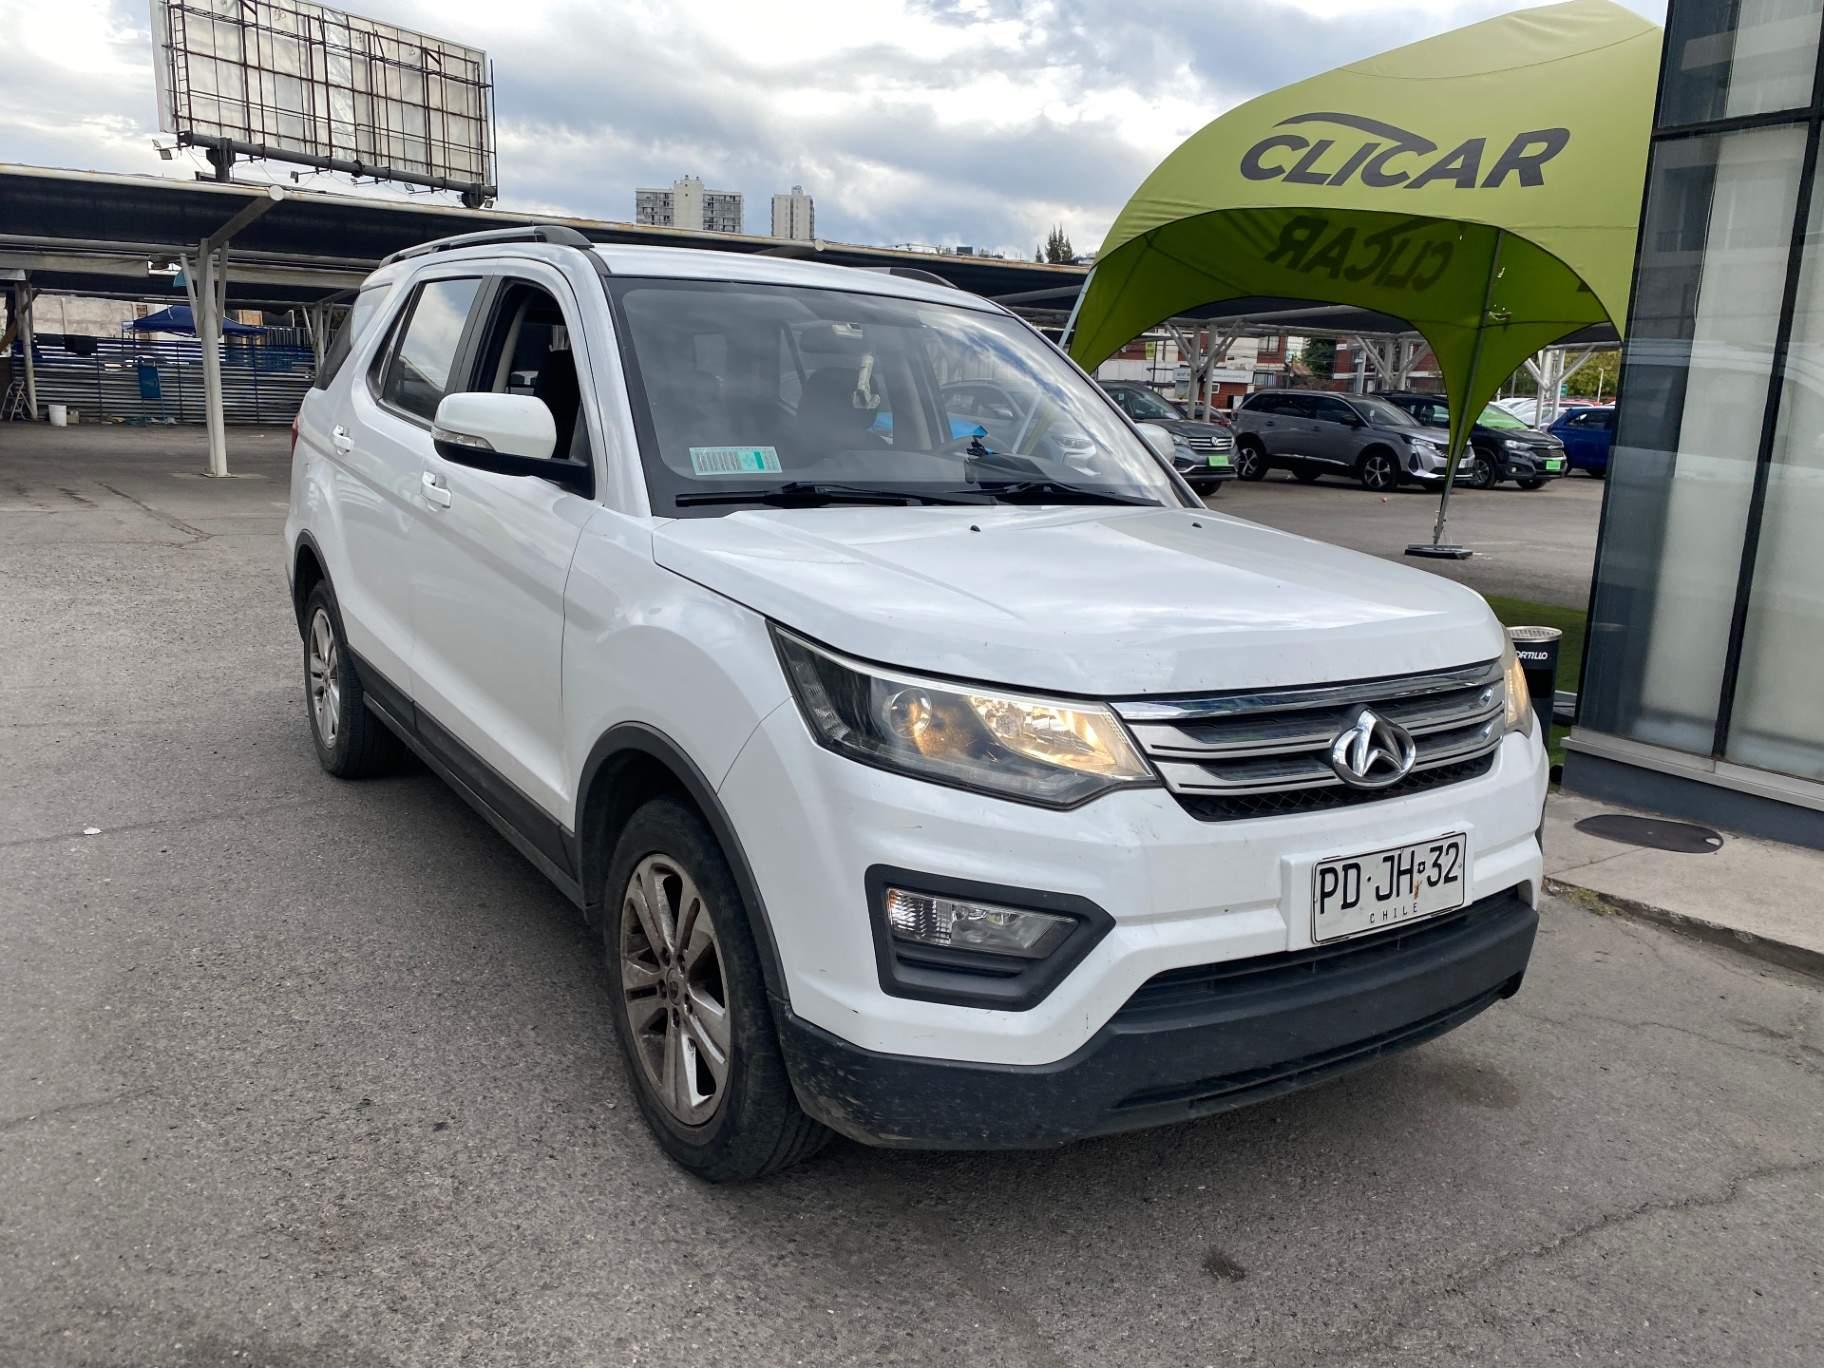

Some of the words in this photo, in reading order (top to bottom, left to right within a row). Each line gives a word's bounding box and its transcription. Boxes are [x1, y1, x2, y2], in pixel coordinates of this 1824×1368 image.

[1240, 122, 1571, 189] CLICAR
[1515, 650, 1549, 660] ORTILLO
[1369, 902, 1418, 924] CHILE
